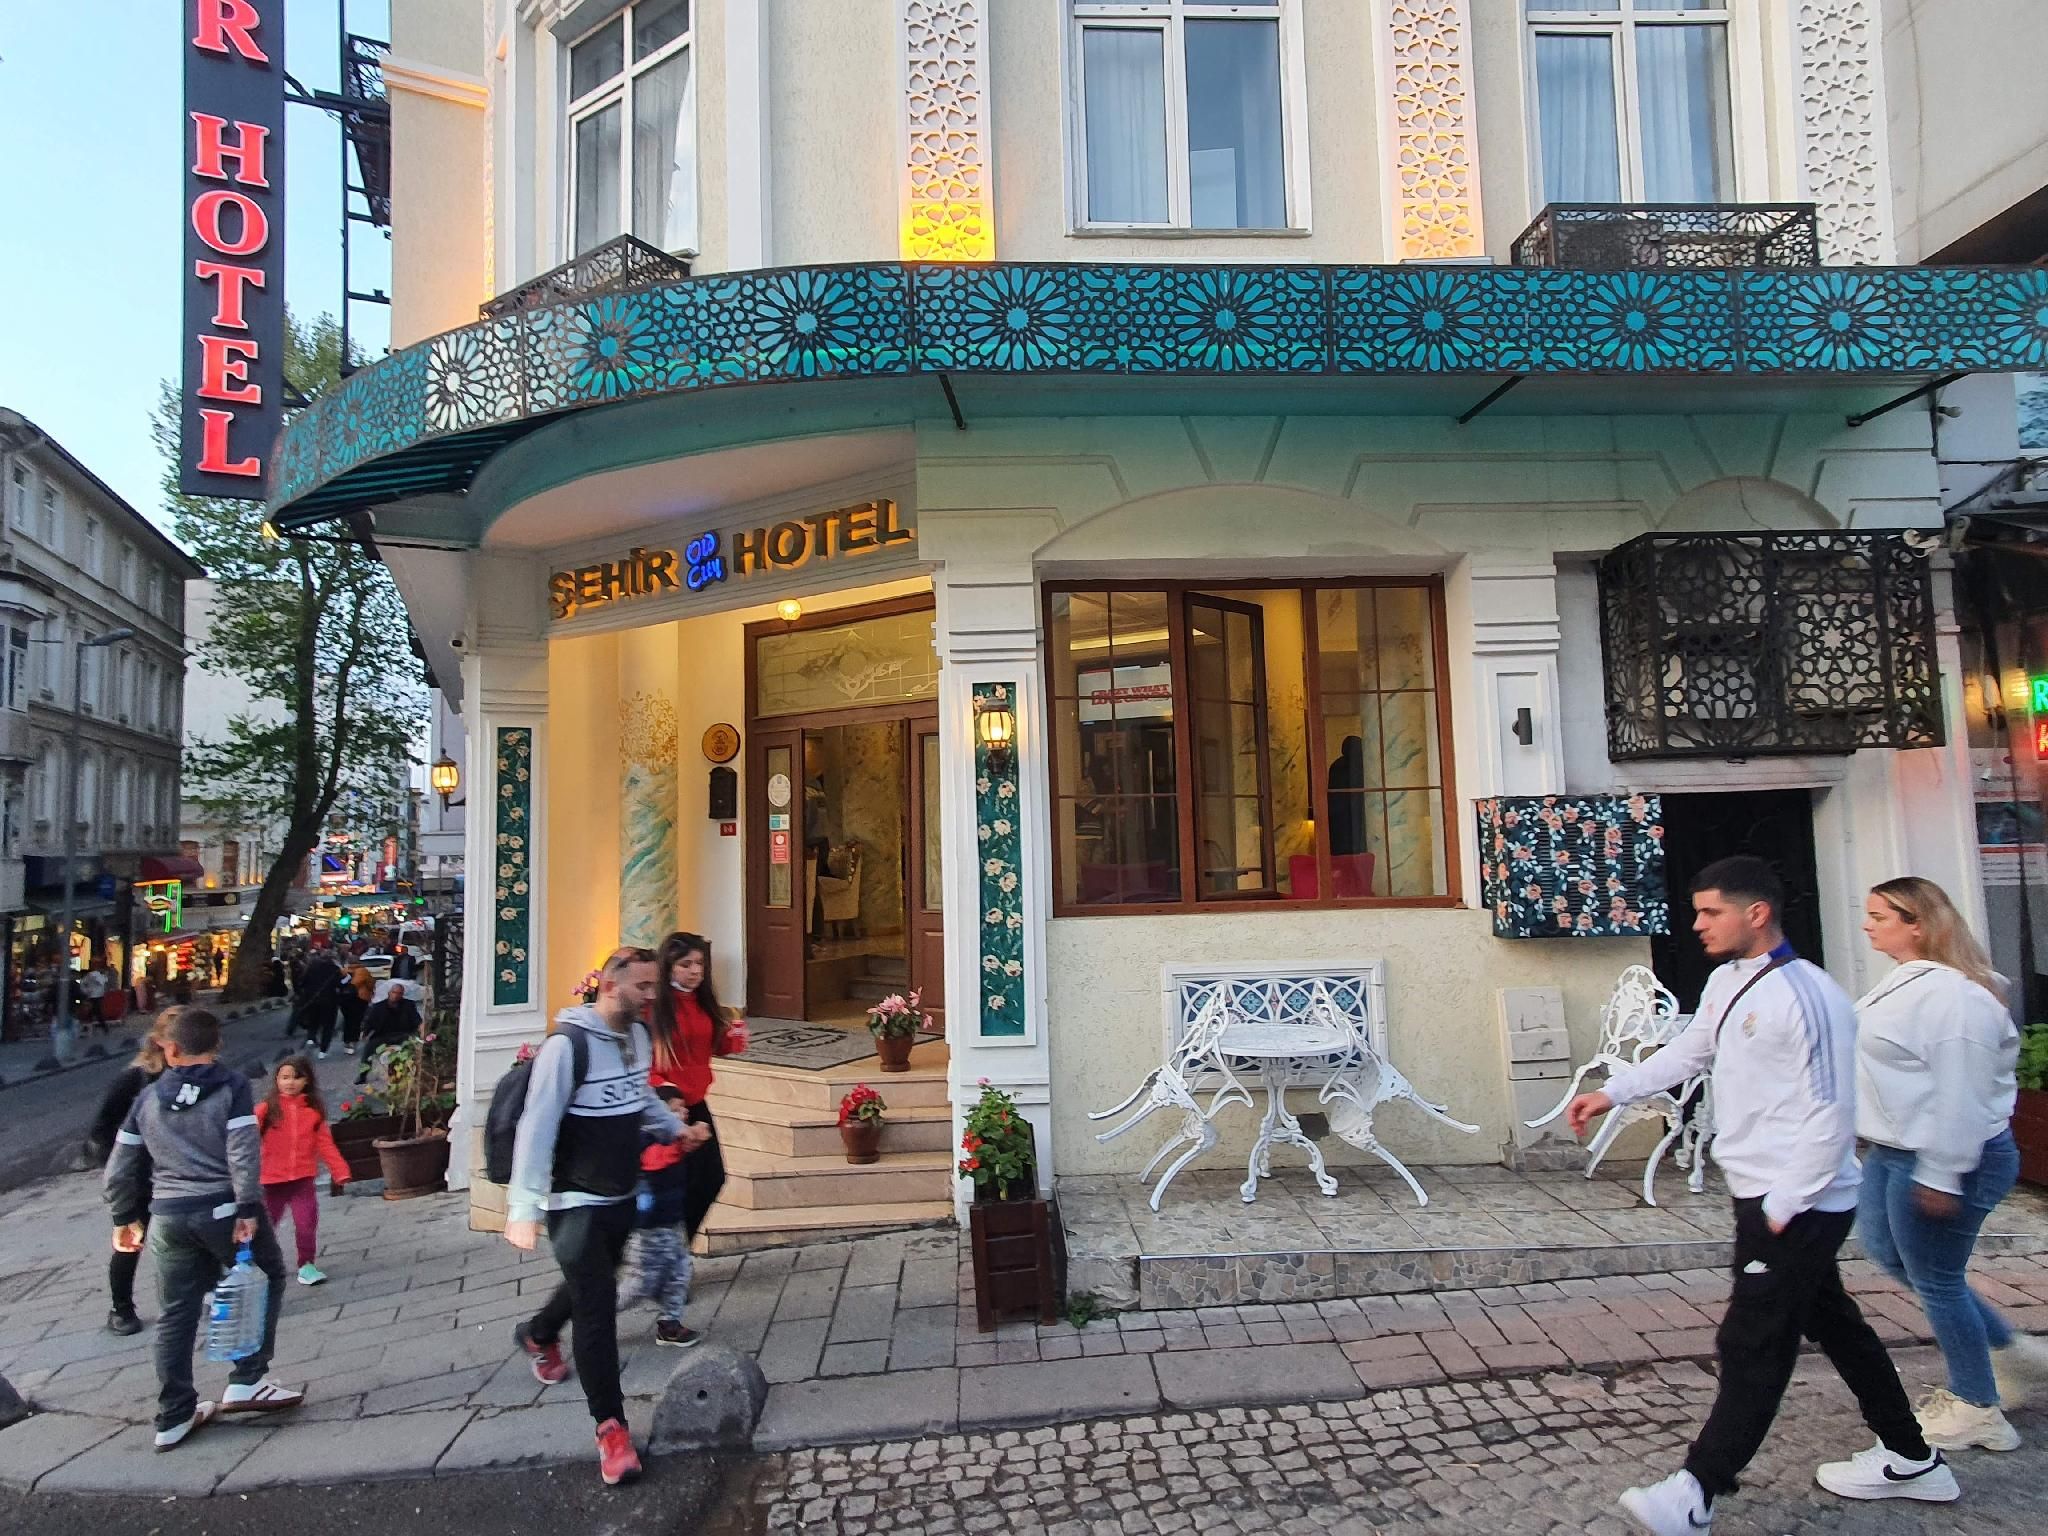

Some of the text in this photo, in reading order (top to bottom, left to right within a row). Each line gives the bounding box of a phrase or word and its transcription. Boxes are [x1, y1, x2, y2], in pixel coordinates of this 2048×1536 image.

[190, 0, 270, 477] R HOTEL
[732, 498, 914, 576] HOTEL
